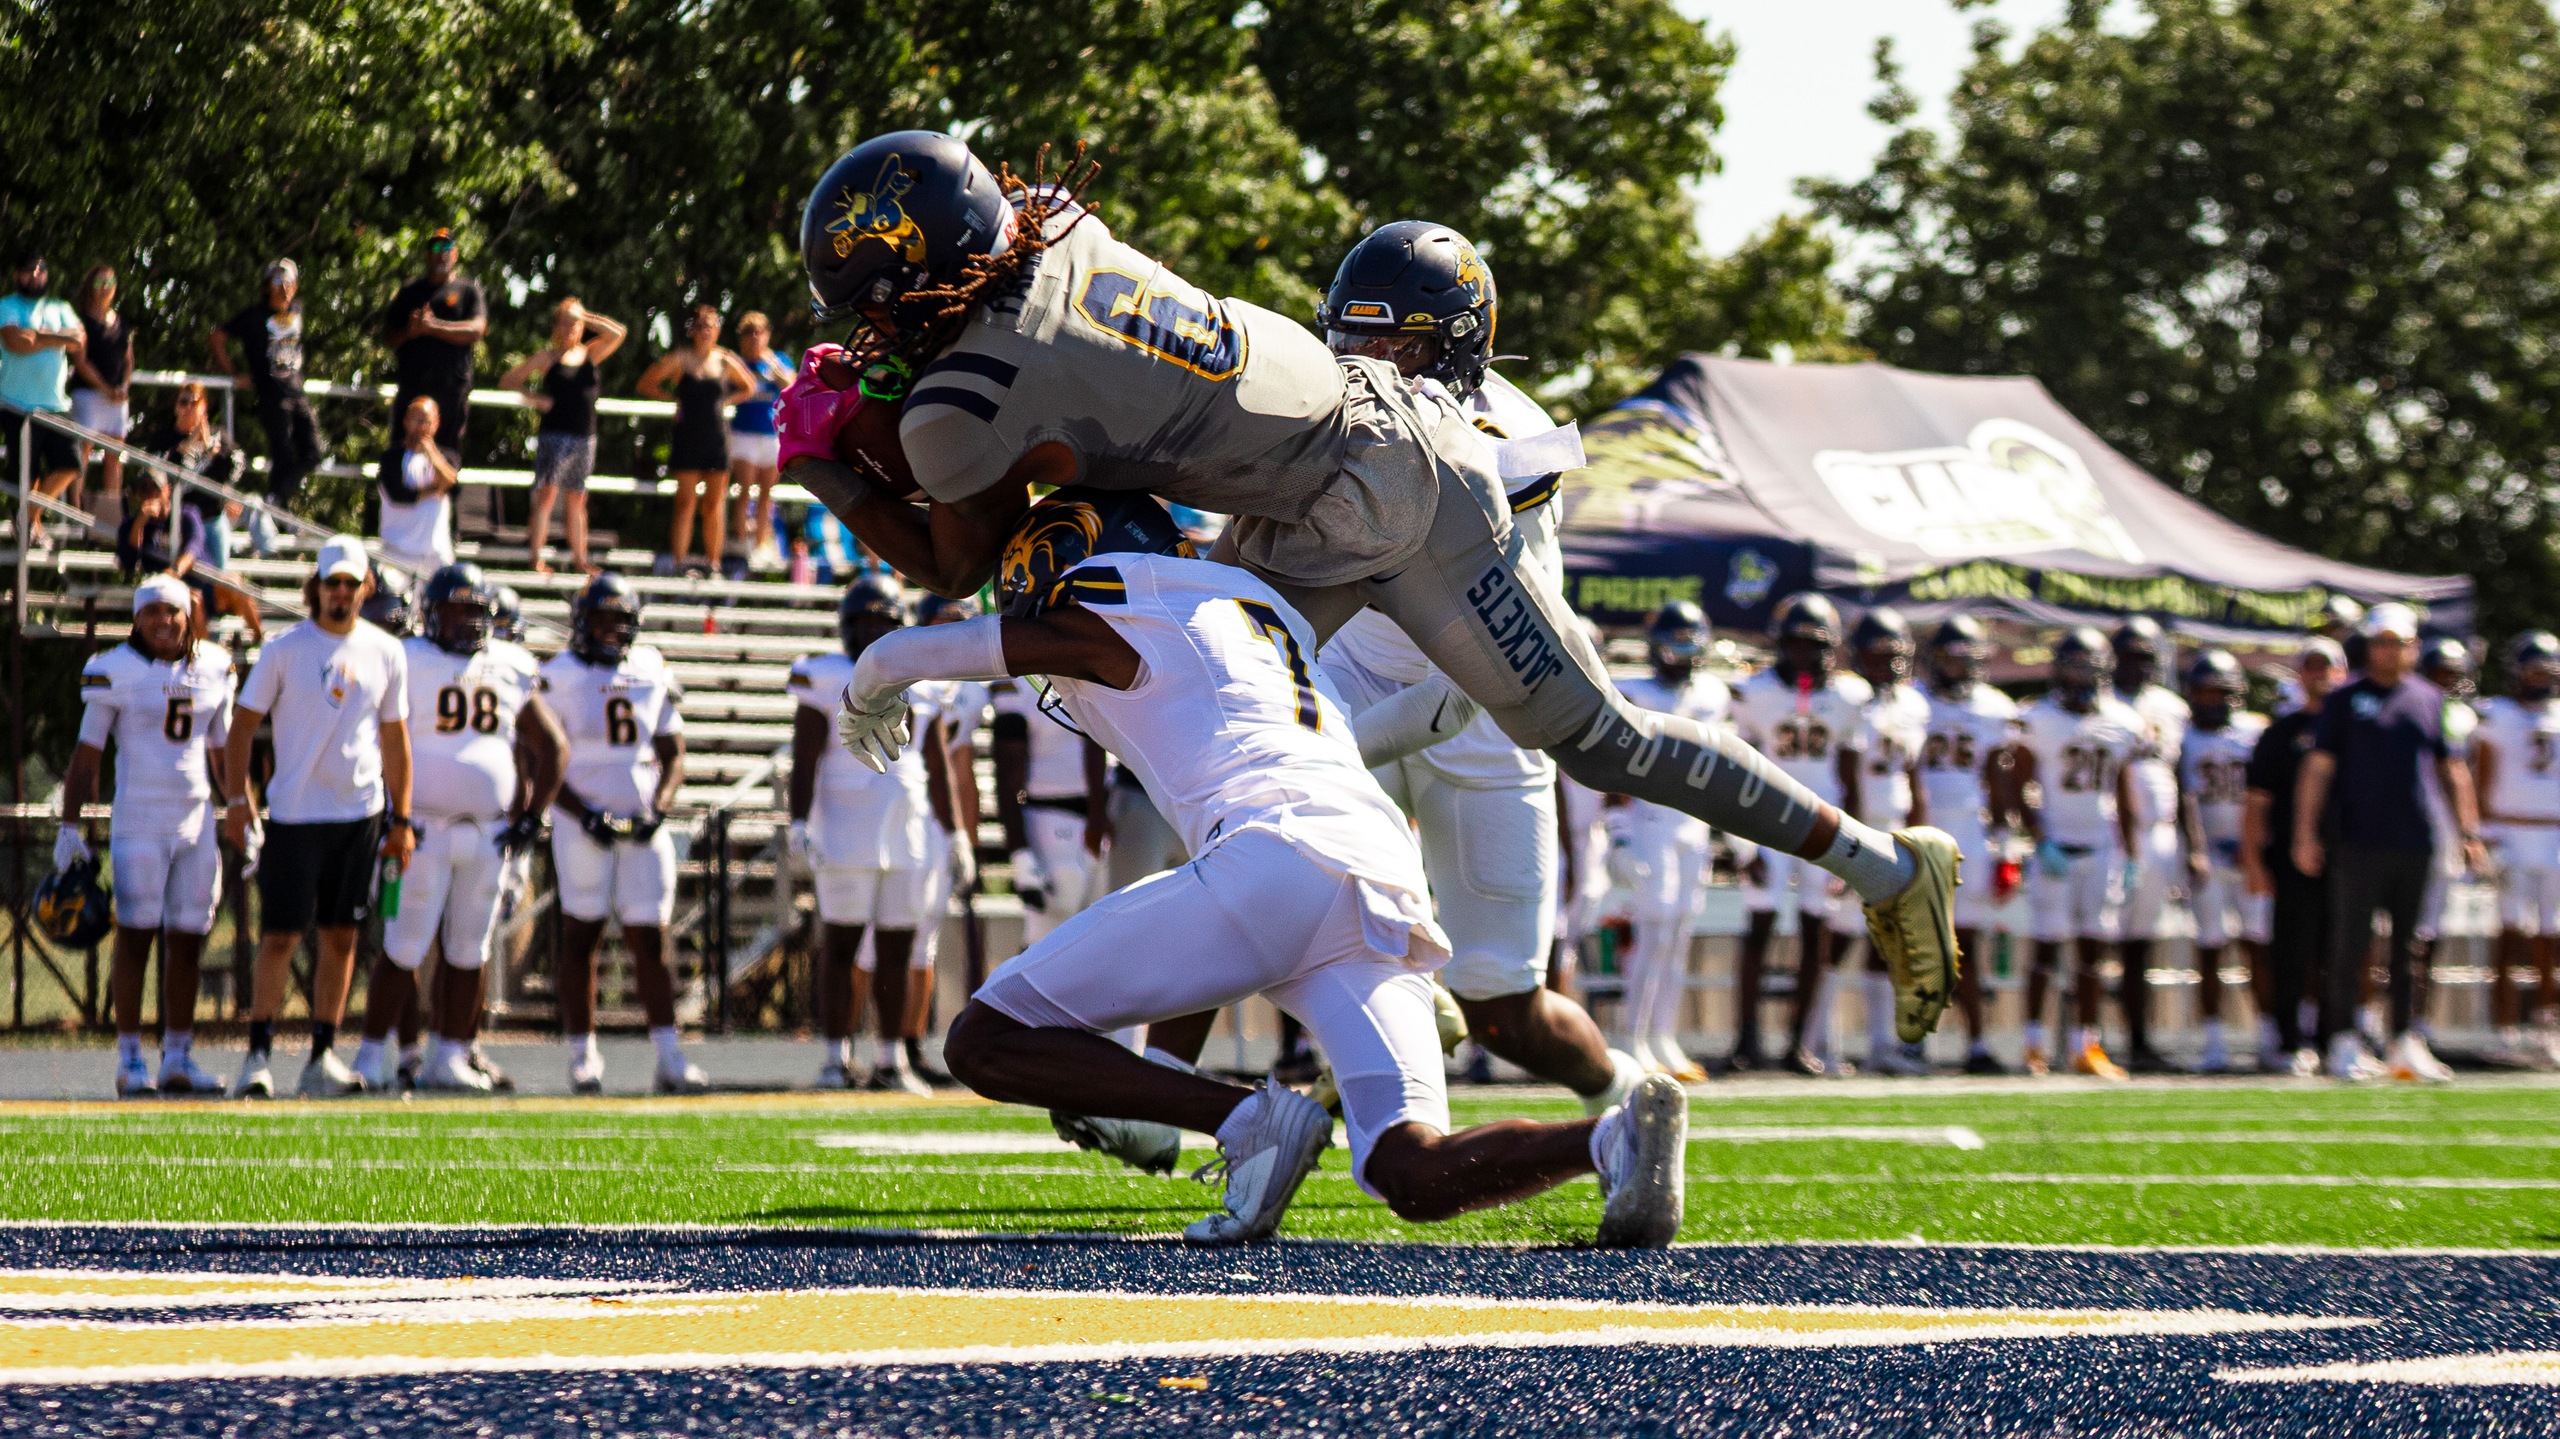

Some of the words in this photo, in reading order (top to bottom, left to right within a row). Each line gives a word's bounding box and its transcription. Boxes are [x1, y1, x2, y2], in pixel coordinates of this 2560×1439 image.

[1072, 267, 1249, 383] 6
[1232, 597, 1322, 736] 7
[1466, 566, 1564, 695] JACKETS
[435, 685, 499, 735] 98
[604, 695, 638, 749] 6
